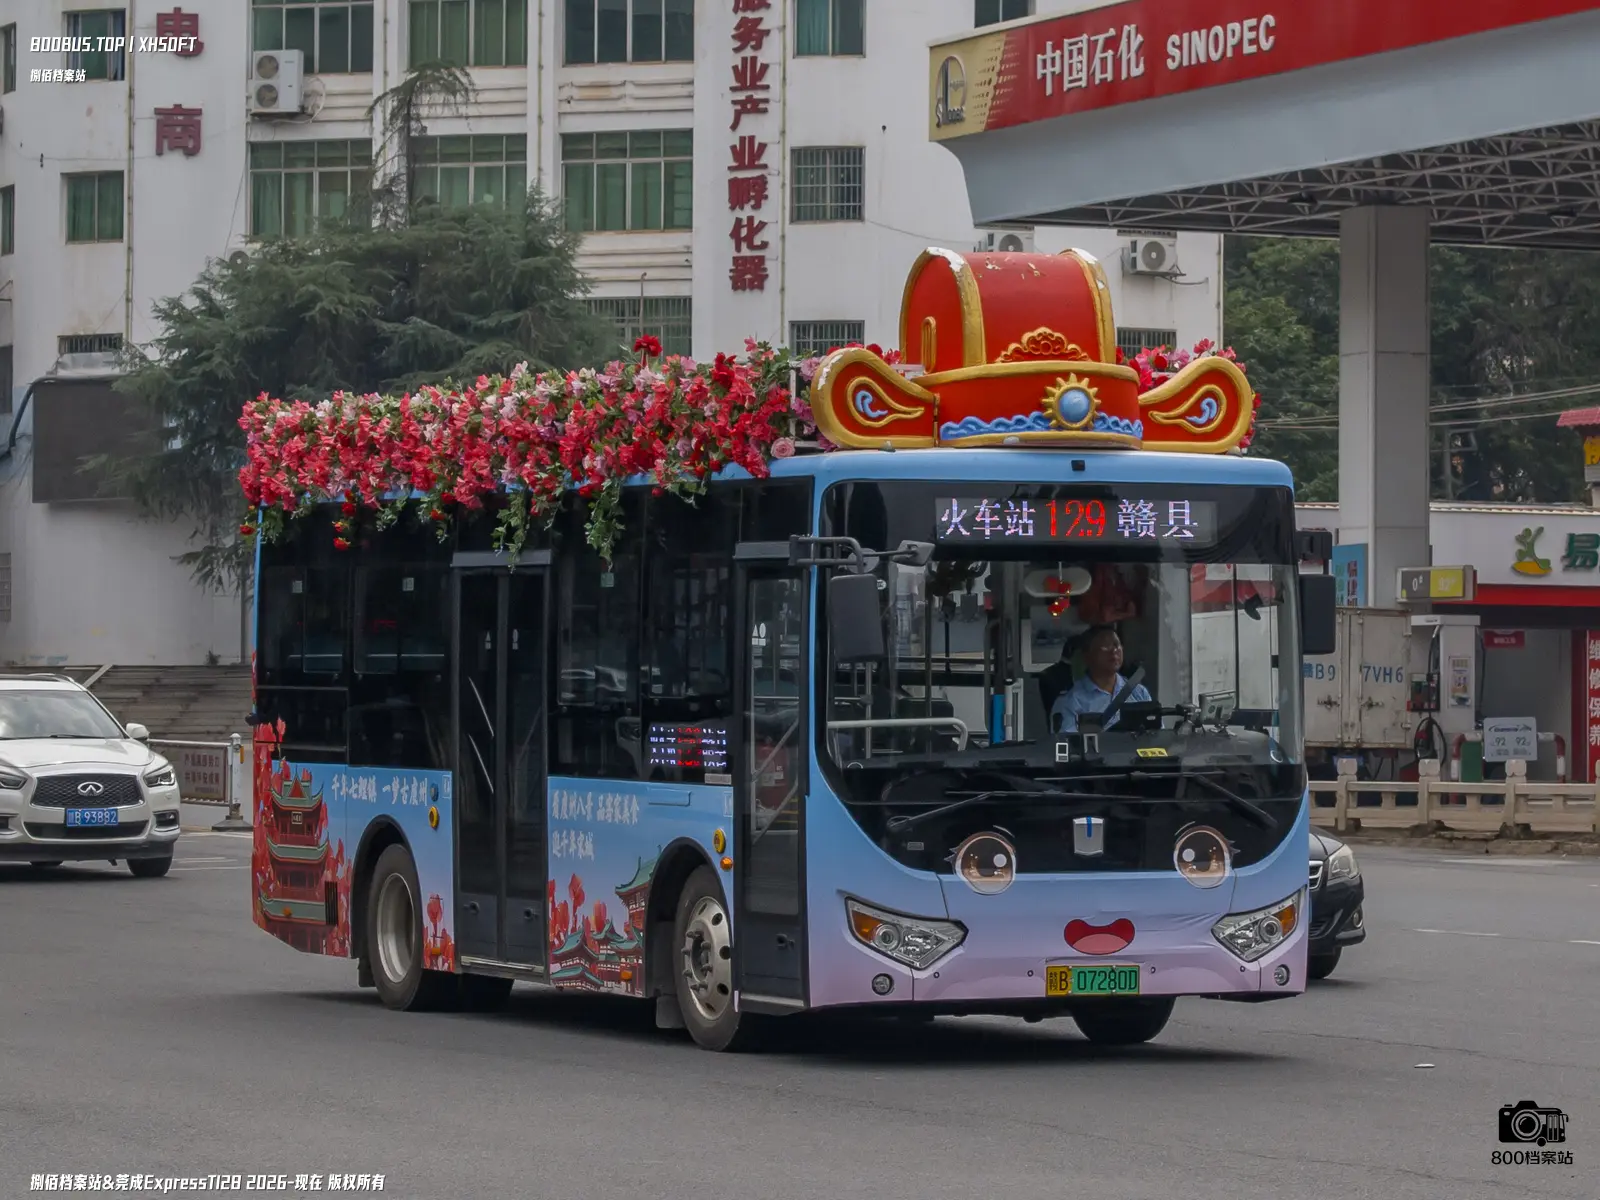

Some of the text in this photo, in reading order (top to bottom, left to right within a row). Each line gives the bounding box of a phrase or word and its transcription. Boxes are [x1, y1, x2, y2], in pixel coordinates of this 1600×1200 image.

[1037, 14, 1276, 96] 中国石化 SINOPEC
[939, 497, 1199, 540] 火车站 129 赣县
[1362, 665, 1404, 684] 7VH6
[1495, 736, 1526, 747] 92 92
